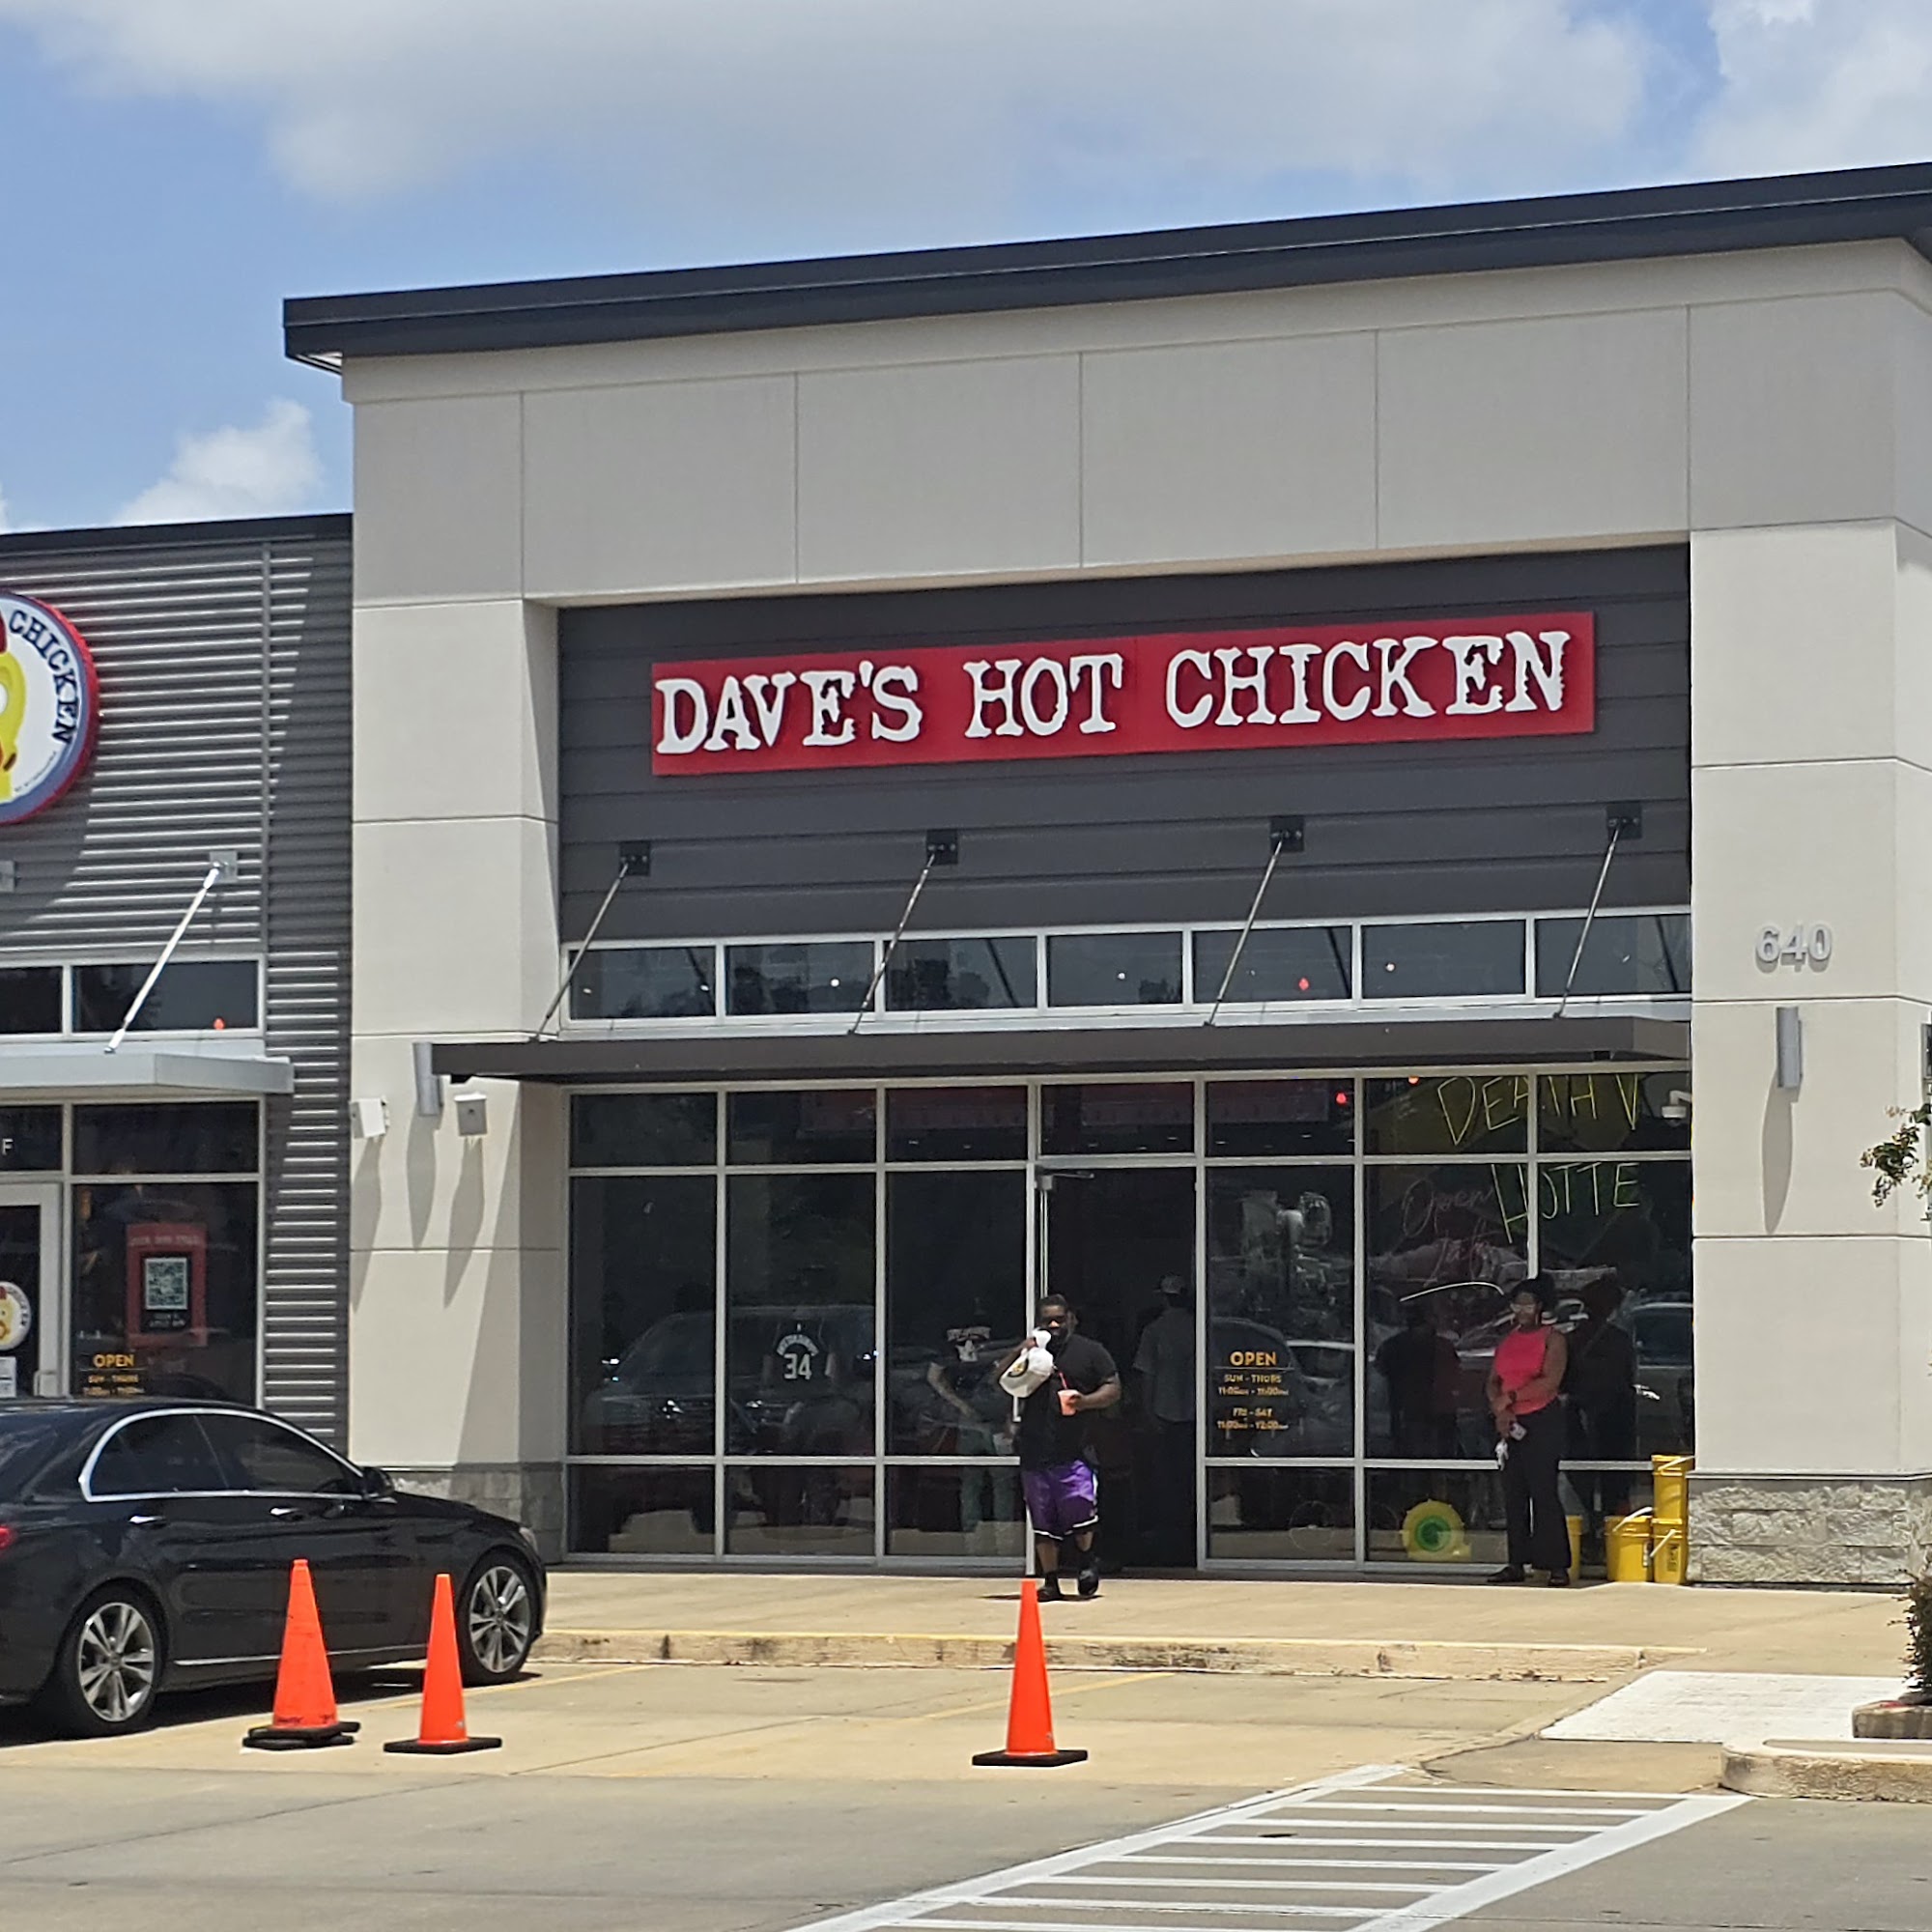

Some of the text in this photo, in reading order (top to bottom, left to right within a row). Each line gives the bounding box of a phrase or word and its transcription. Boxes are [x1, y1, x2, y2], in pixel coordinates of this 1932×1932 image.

[9, 610, 79, 744] CHICKEN
[655, 631, 1571, 753] DAVE'S HOT CHICKEN
[1755, 923, 1833, 963] 640
[2, 1138, 14, 1155] F
[93, 1353, 135, 1368] OPEN
[783, 1352, 812, 1380] 34
[1230, 1350, 1277, 1367] OPEN
